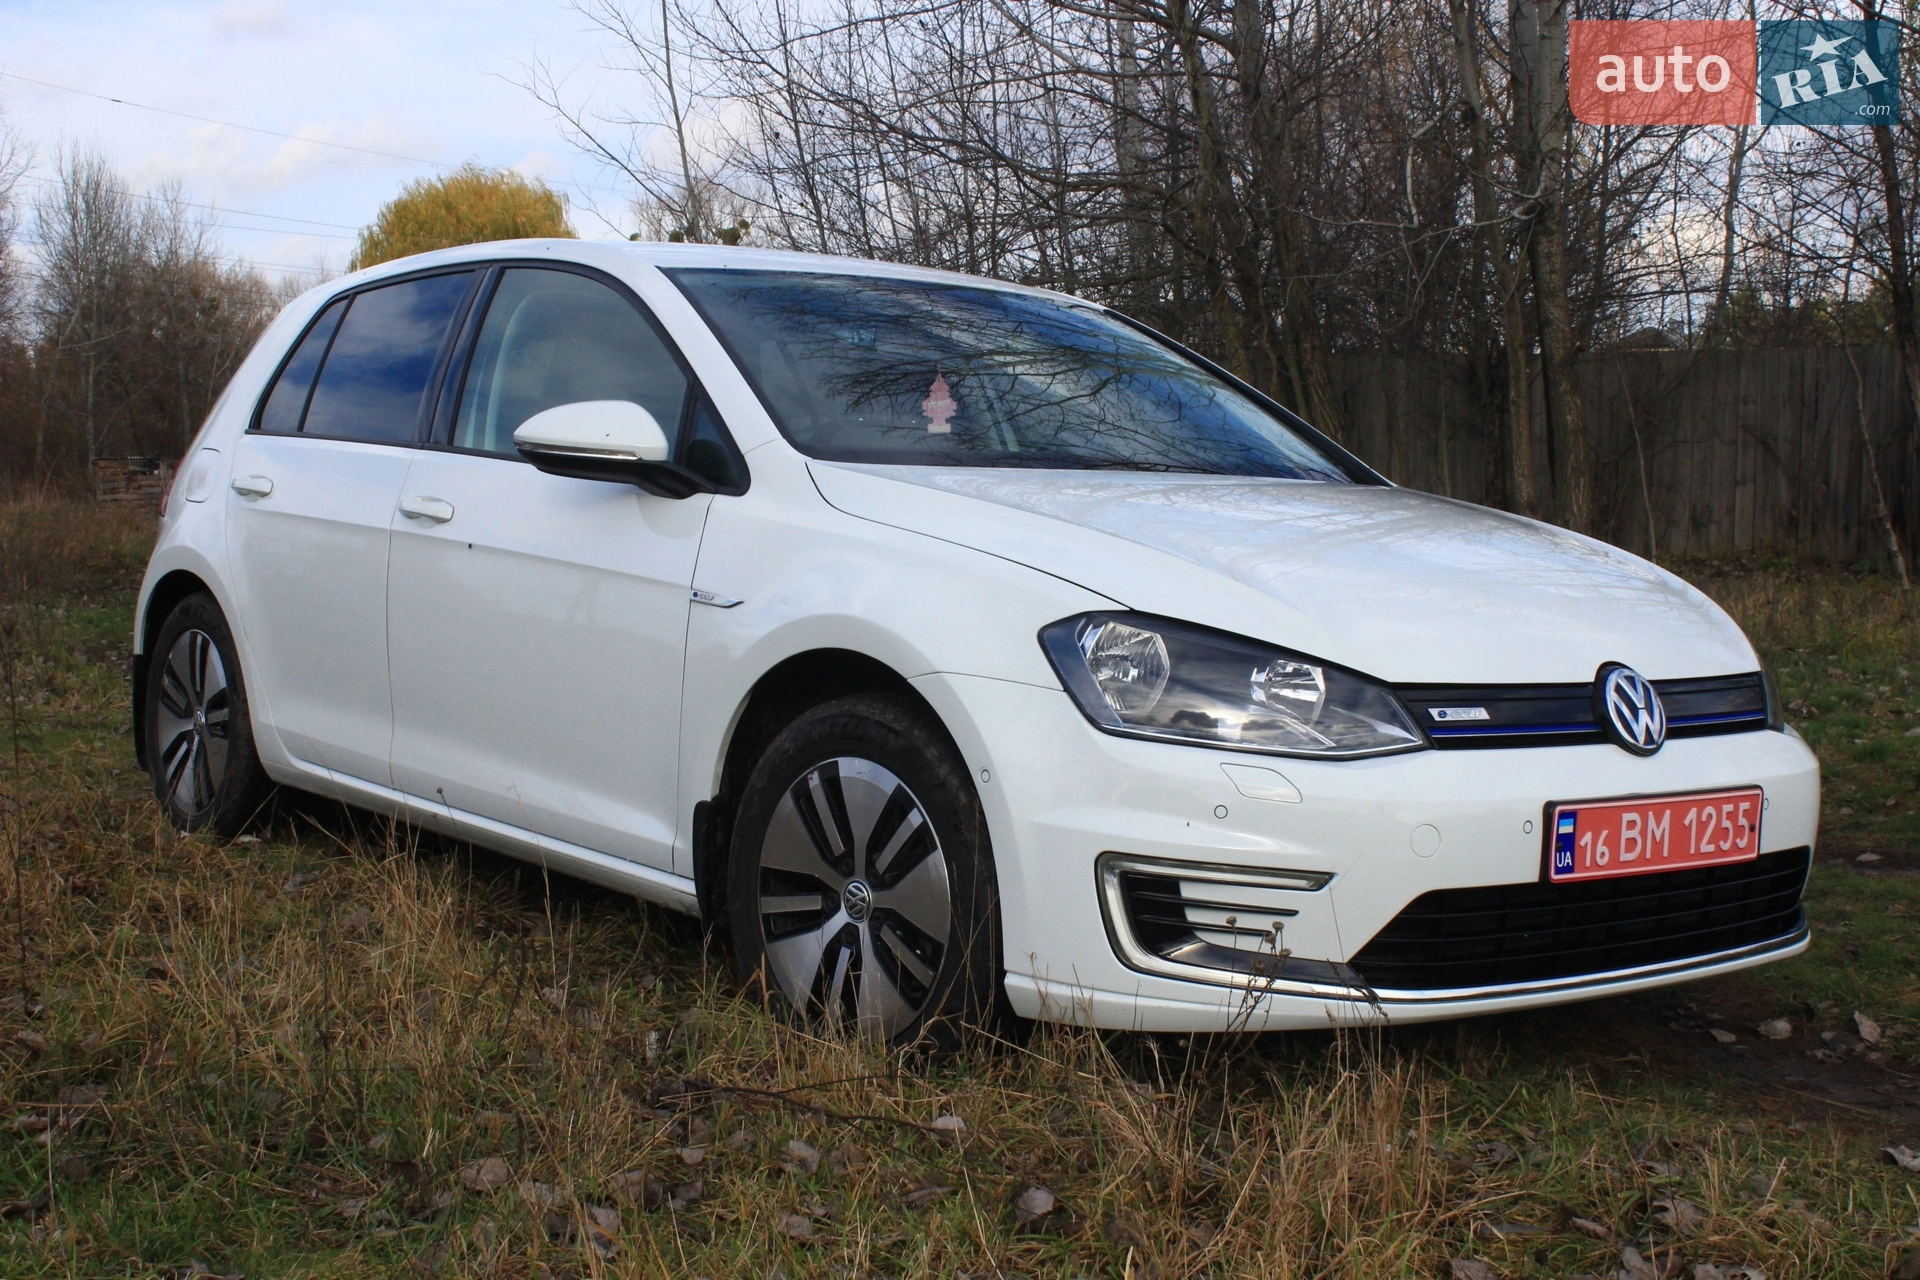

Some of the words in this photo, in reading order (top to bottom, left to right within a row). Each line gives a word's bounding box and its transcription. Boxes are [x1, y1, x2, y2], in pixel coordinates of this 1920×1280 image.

[1579, 830, 1610, 868] 16
[1619, 809, 1671, 863] BM
[1683, 802, 1751, 855] 1255
[1556, 851, 1572, 868] UA
